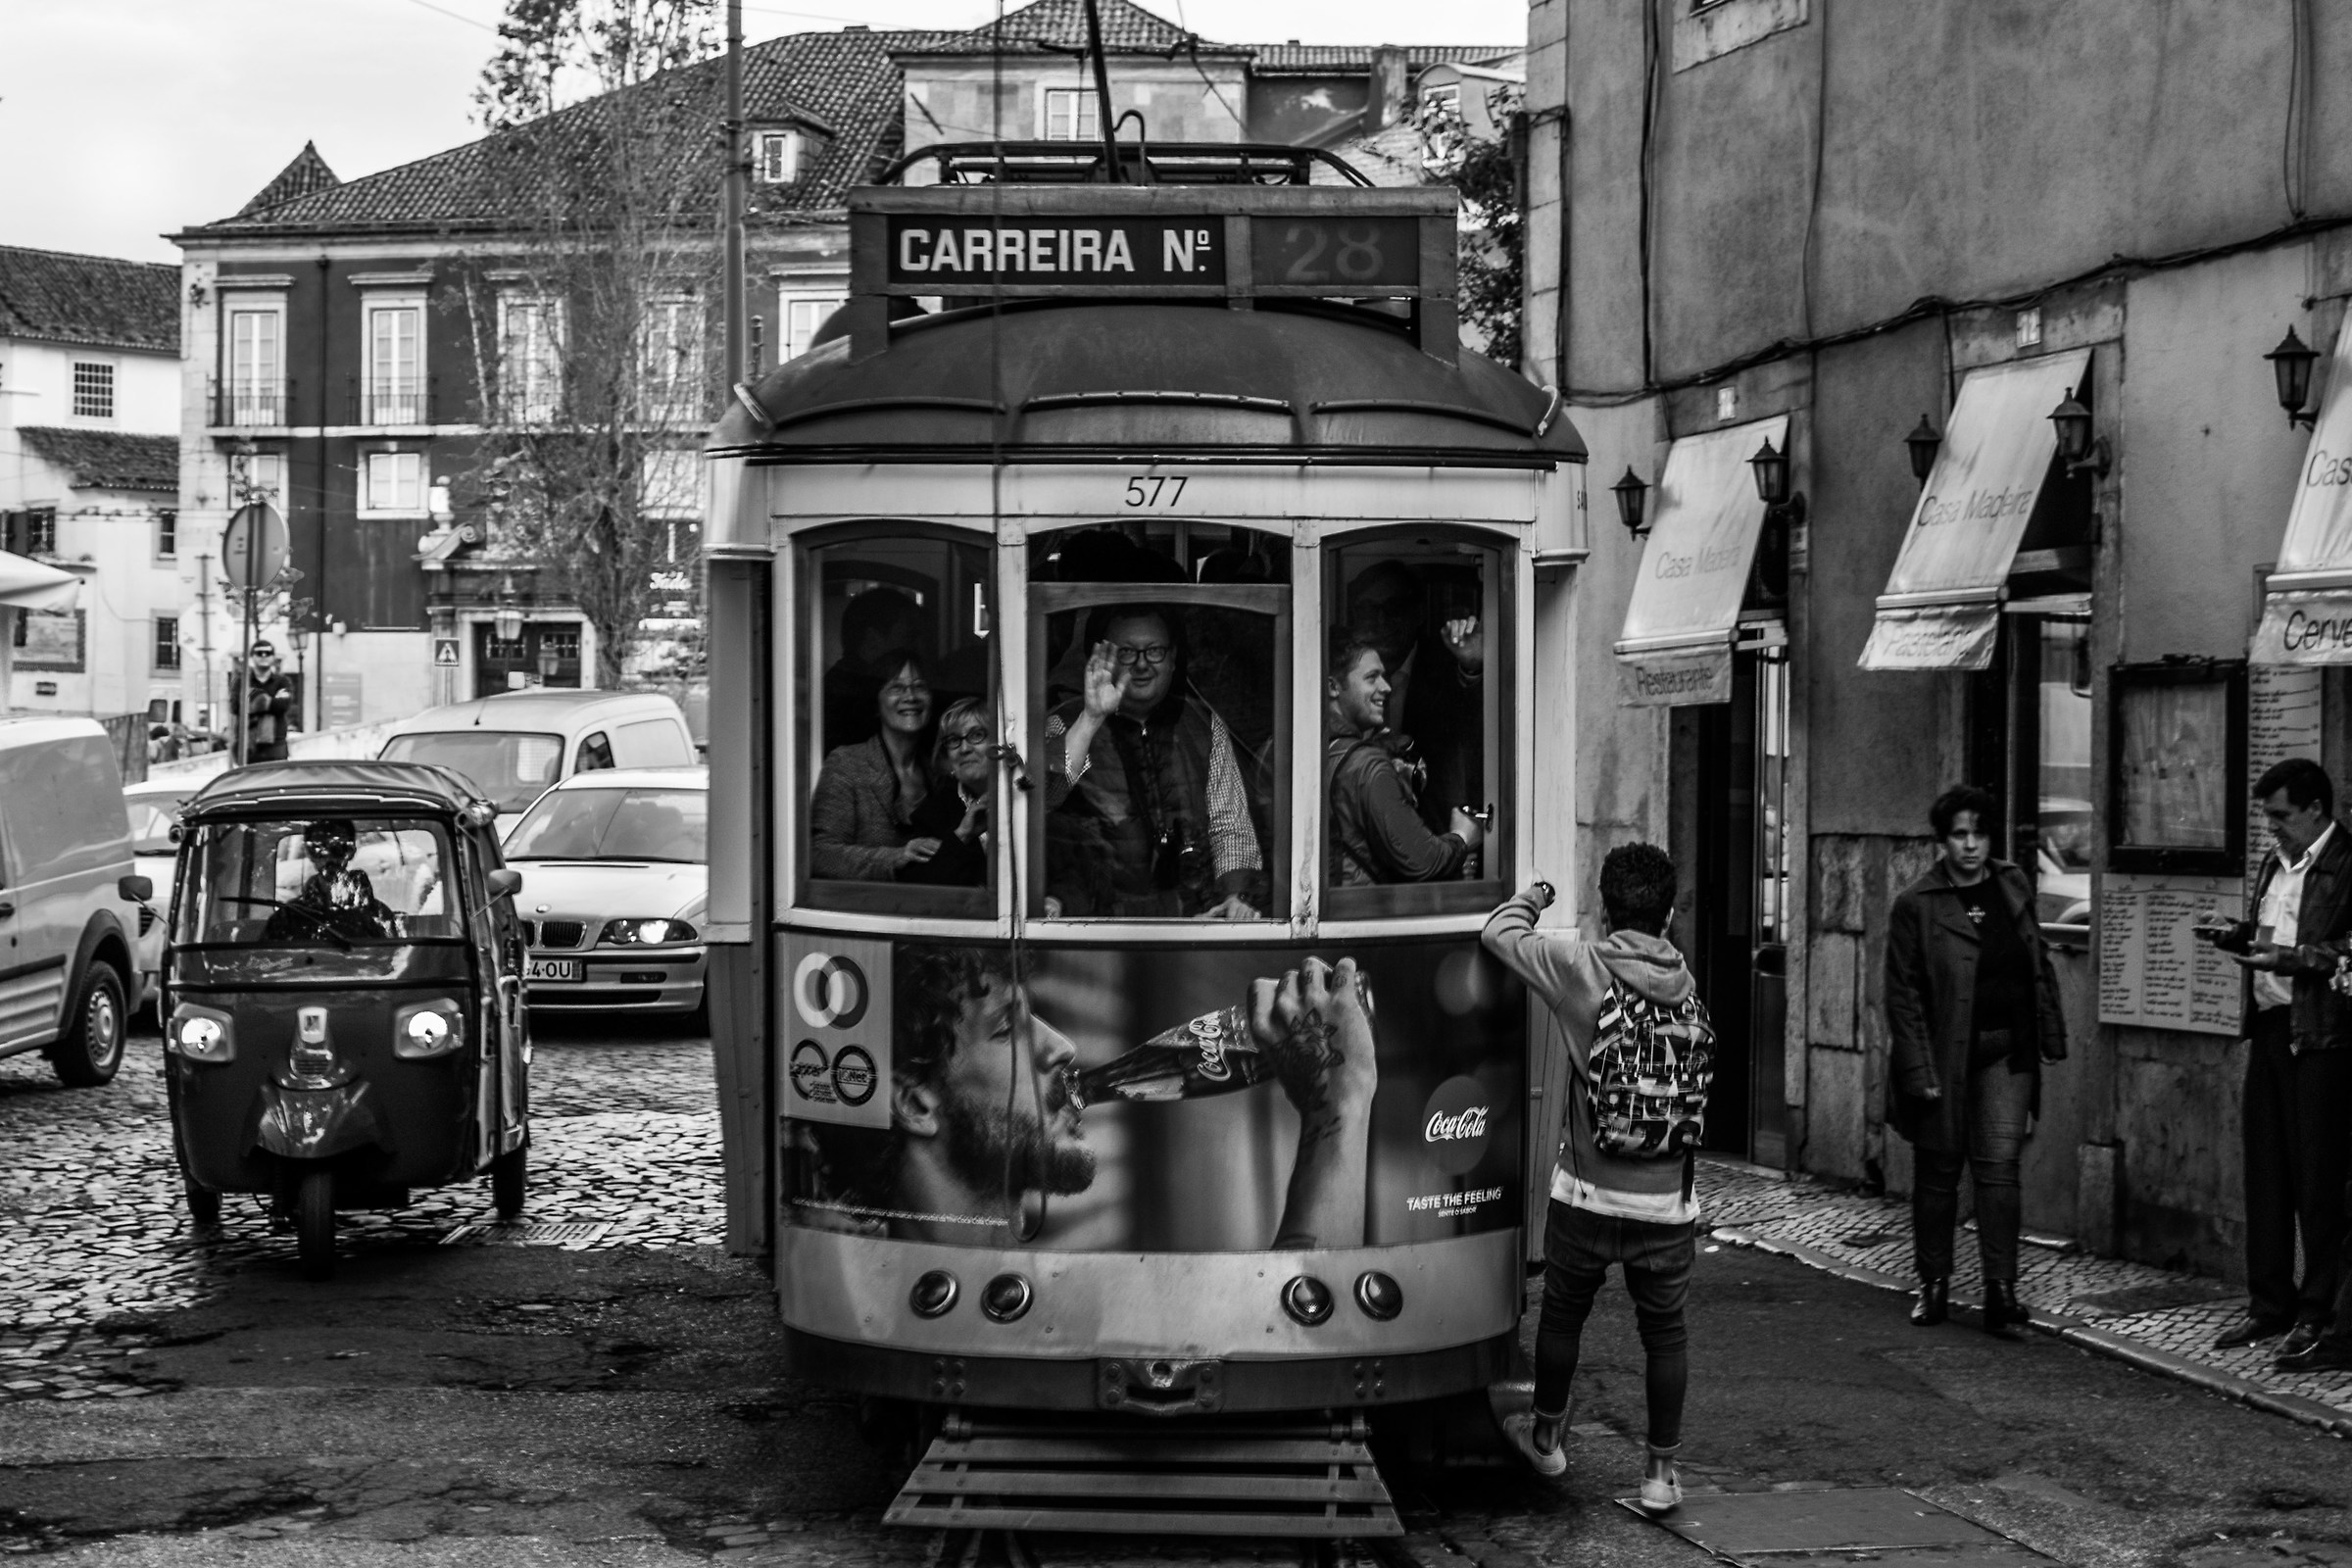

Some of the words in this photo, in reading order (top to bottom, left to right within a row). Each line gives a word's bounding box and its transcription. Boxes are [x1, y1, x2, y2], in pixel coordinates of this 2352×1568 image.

[899, 228, 1136, 272] CARREIRA
[1284, 224, 1386, 281] 28
[2306, 450, 2352, 487] Cas
[1124, 475, 1190, 508] 577
[1918, 495, 1962, 527] Casa
[1963, 485, 2034, 521] Madeira
[1655, 551, 1692, 579] Casa
[1636, 662, 1713, 696] Restaurante
[1406, 1195, 1442, 1211] TASTE
[1443, 1192, 1463, 1207] THE
[1464, 1186, 1502, 1205] FEELING
